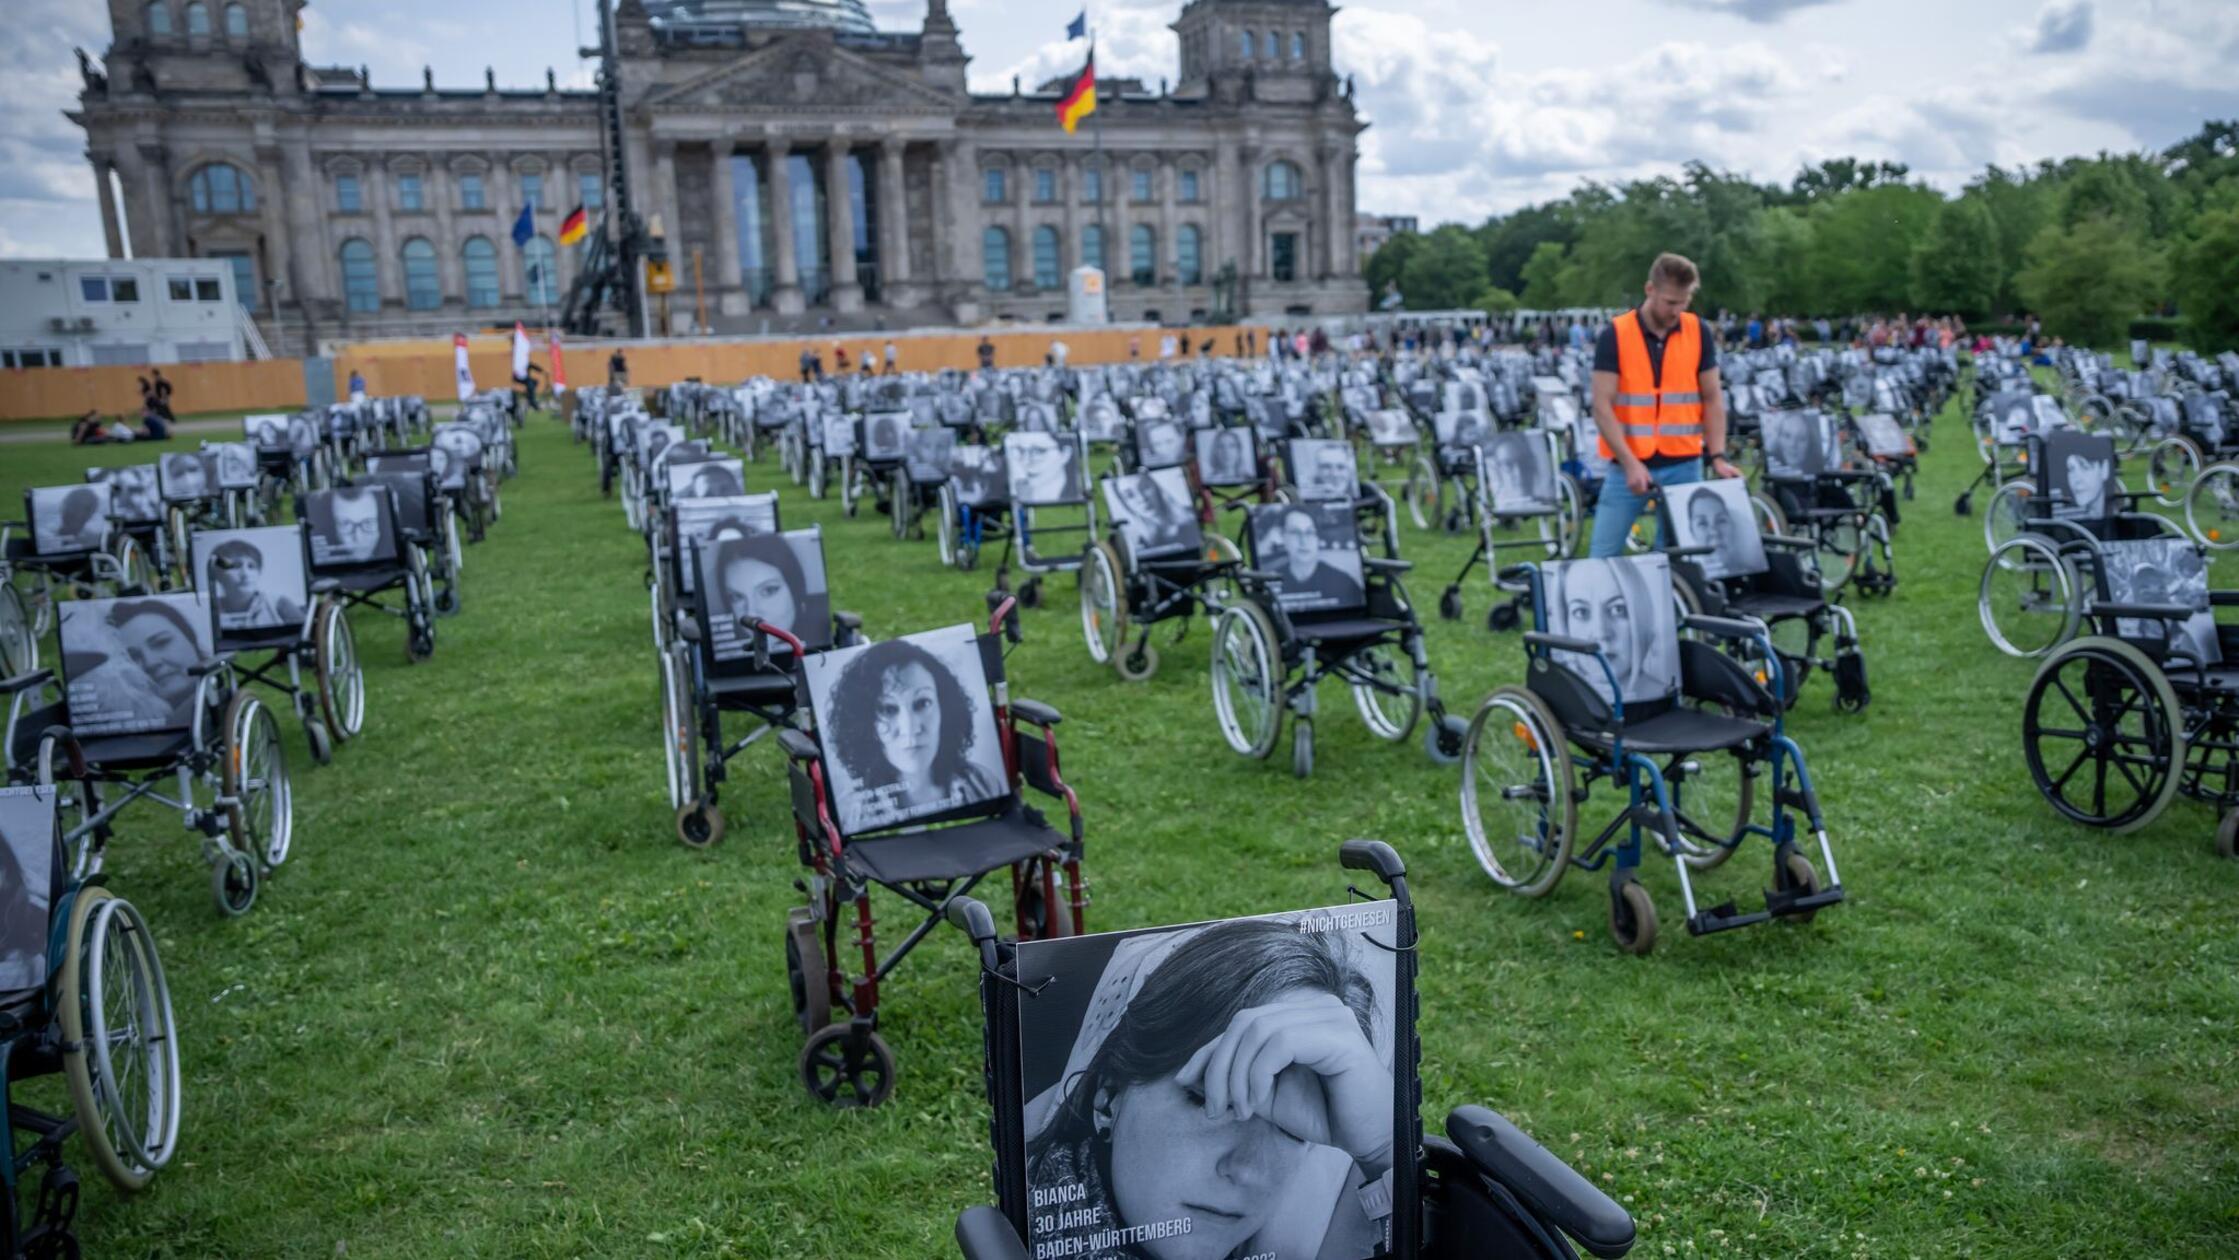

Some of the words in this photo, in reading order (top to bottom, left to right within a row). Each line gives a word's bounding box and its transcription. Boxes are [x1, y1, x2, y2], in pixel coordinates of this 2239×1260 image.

[1300, 909, 1390, 934] #NICHTGENESEN
[1034, 1183, 1086, 1207] BIANCA
[1035, 1215, 1054, 1234] 30
[1057, 1207, 1101, 1230] JAHRE
[1037, 1217, 1192, 1259] BADEN-WÜRTTEMBERG
